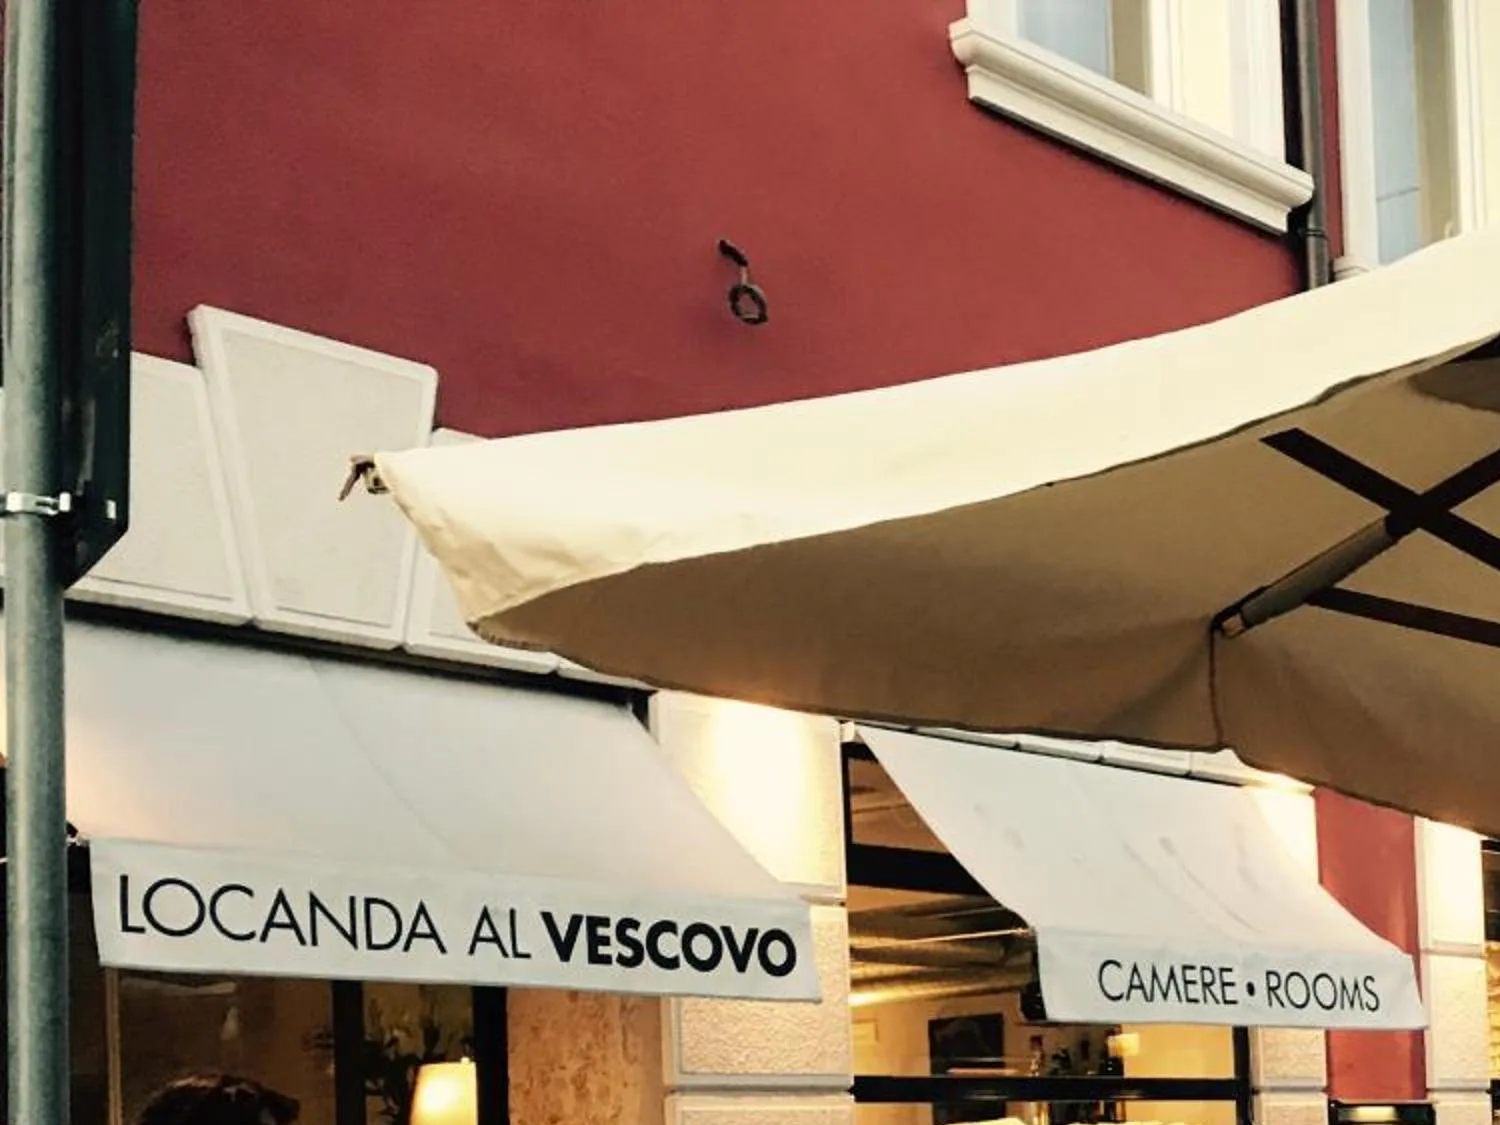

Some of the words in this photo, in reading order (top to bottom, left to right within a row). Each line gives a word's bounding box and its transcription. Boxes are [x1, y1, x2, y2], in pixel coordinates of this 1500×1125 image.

[119, 875, 447, 953] LOCANDA
[468, 906, 531, 959] AL
[540, 911, 798, 977] VESCOVO
[1098, 960, 1238, 1006] CAMERE
[1265, 970, 1381, 1012] ROOMS
